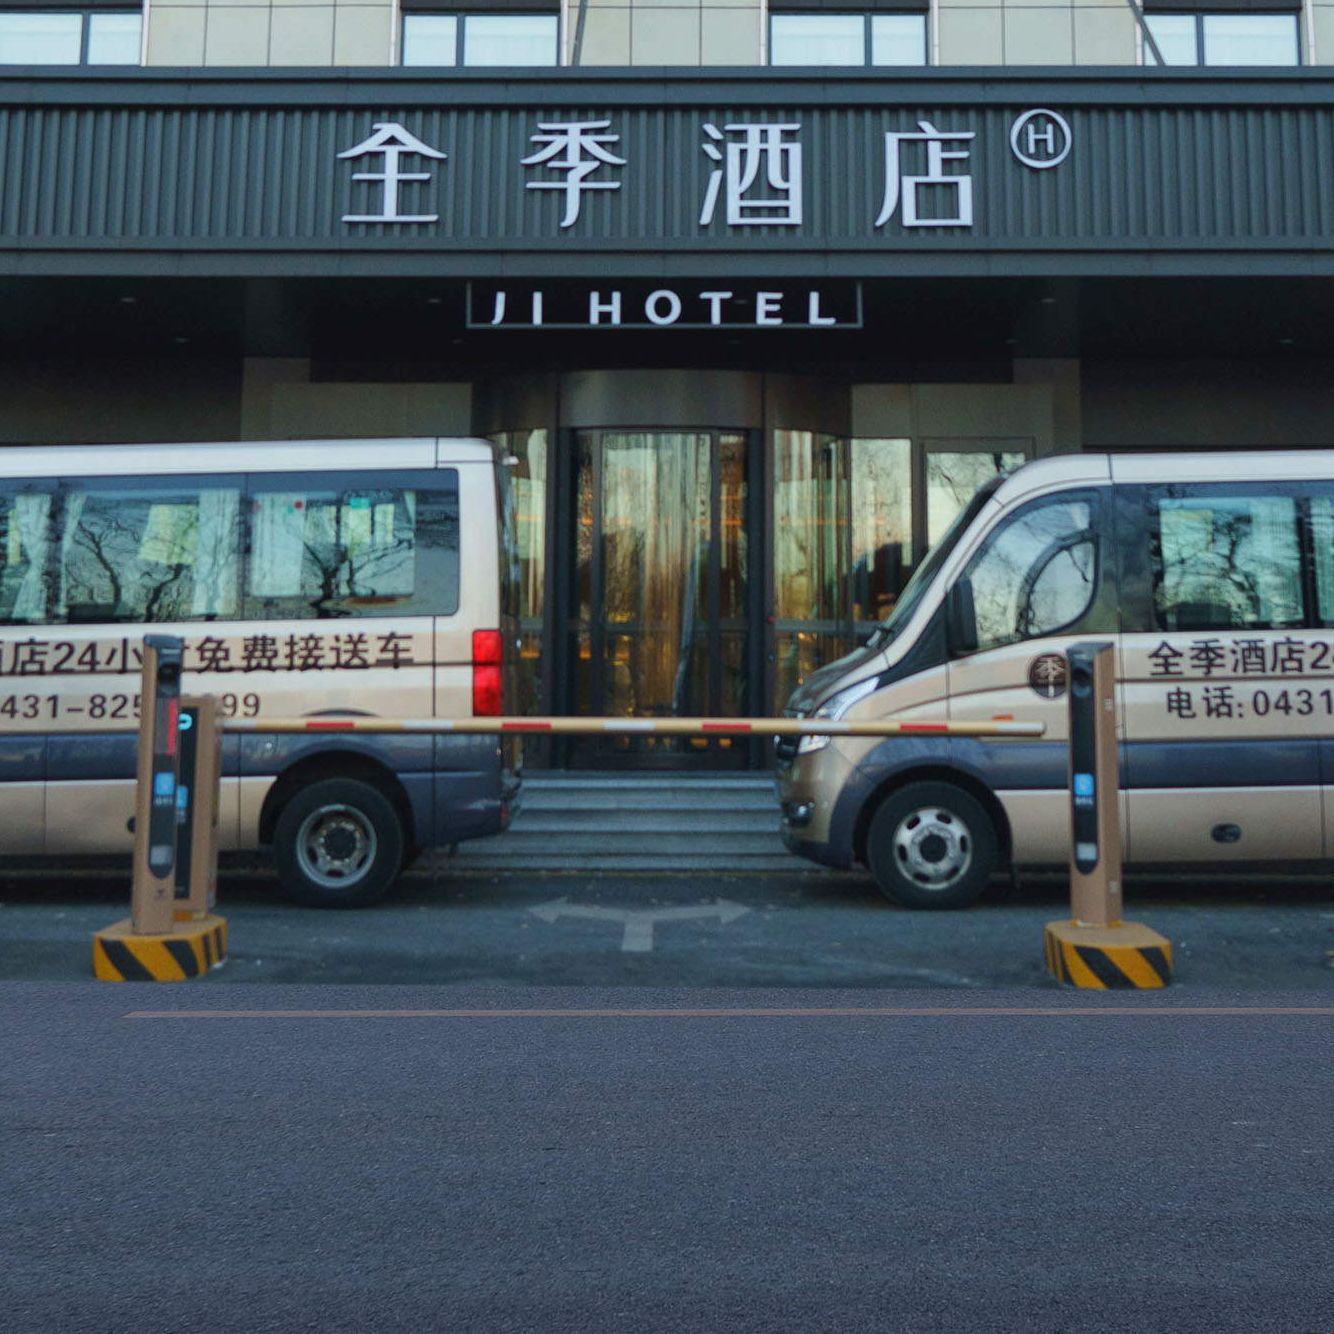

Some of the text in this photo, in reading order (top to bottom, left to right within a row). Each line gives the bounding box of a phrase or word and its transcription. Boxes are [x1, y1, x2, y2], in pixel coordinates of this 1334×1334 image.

[337, 120, 975, 228] 全季酒店
[492, 290, 836, 326] JI HOTEL
